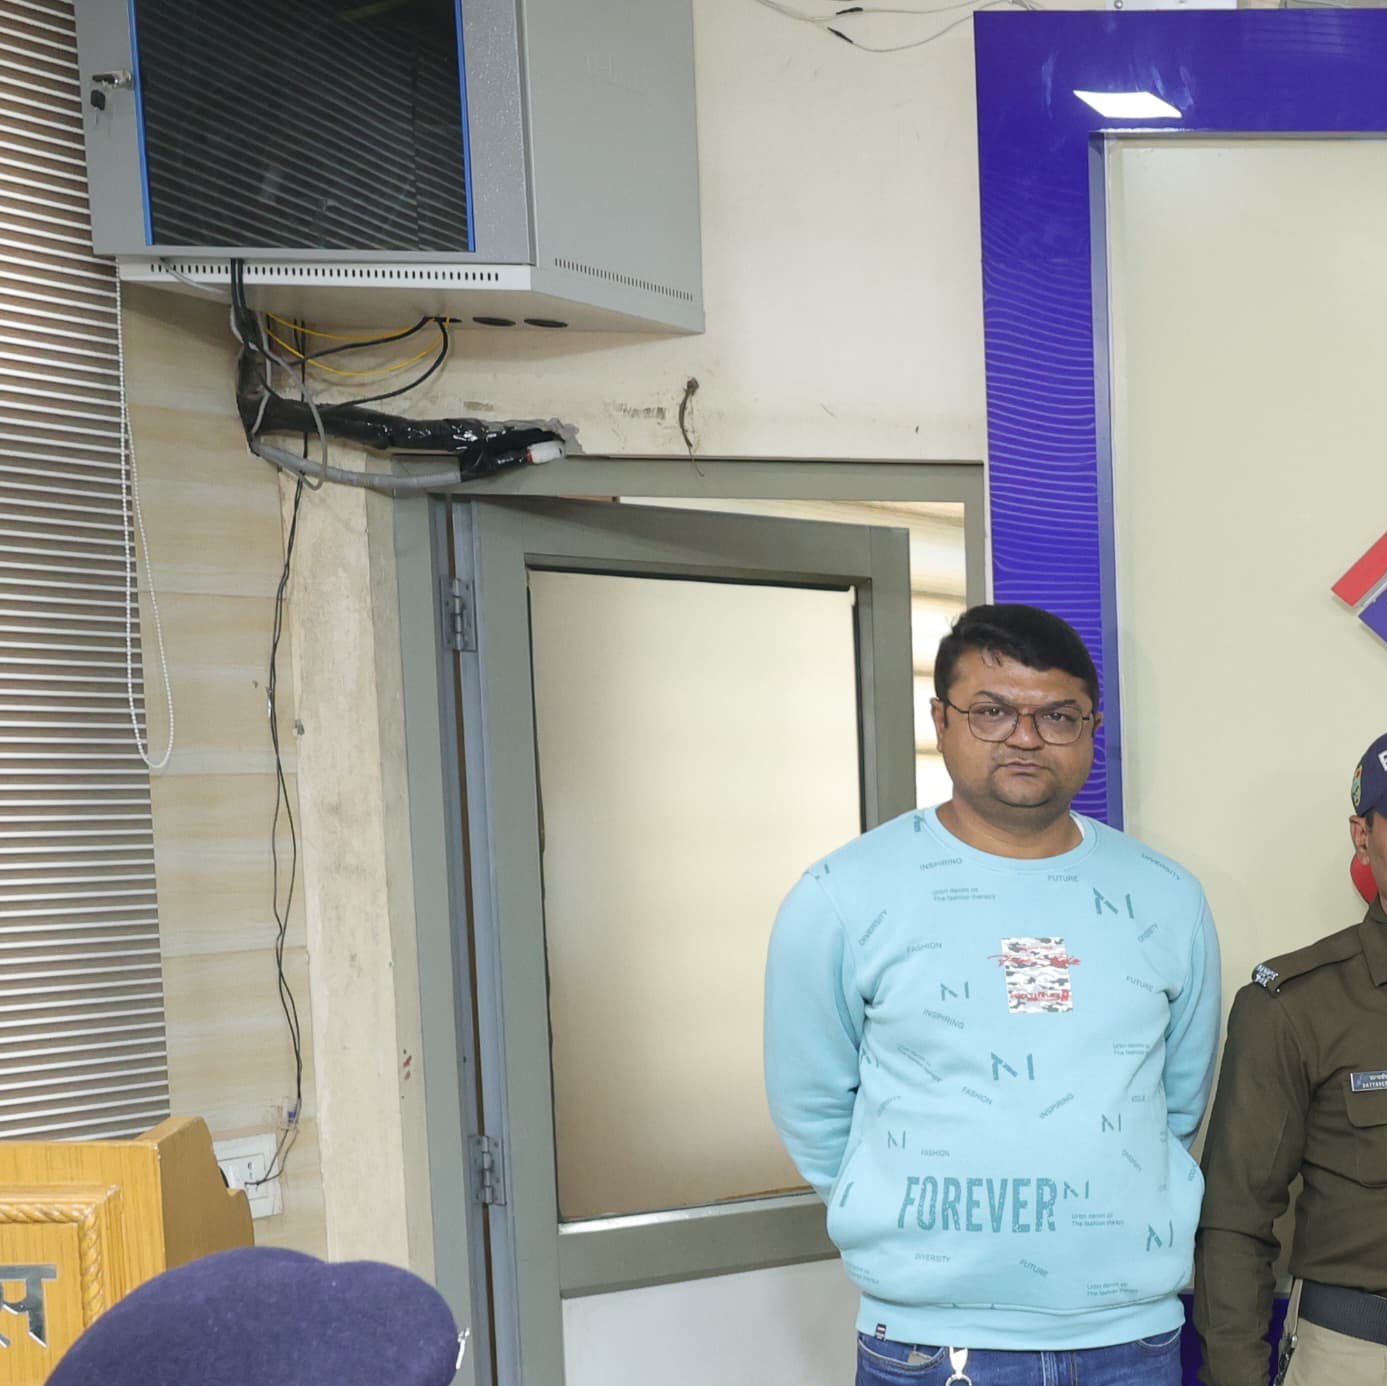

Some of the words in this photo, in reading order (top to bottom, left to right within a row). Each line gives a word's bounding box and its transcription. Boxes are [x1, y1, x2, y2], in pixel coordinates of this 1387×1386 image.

[1048, 874, 1079, 882] FUTURE
[858, 909, 888, 946] DIVERSITY
[906, 942, 942, 953] FASHION
[923, 1008, 965, 1030] INSPIRING
[920, 1149, 951, 1158] FASHION
[897, 1175, 1058, 1234] FOREVER
